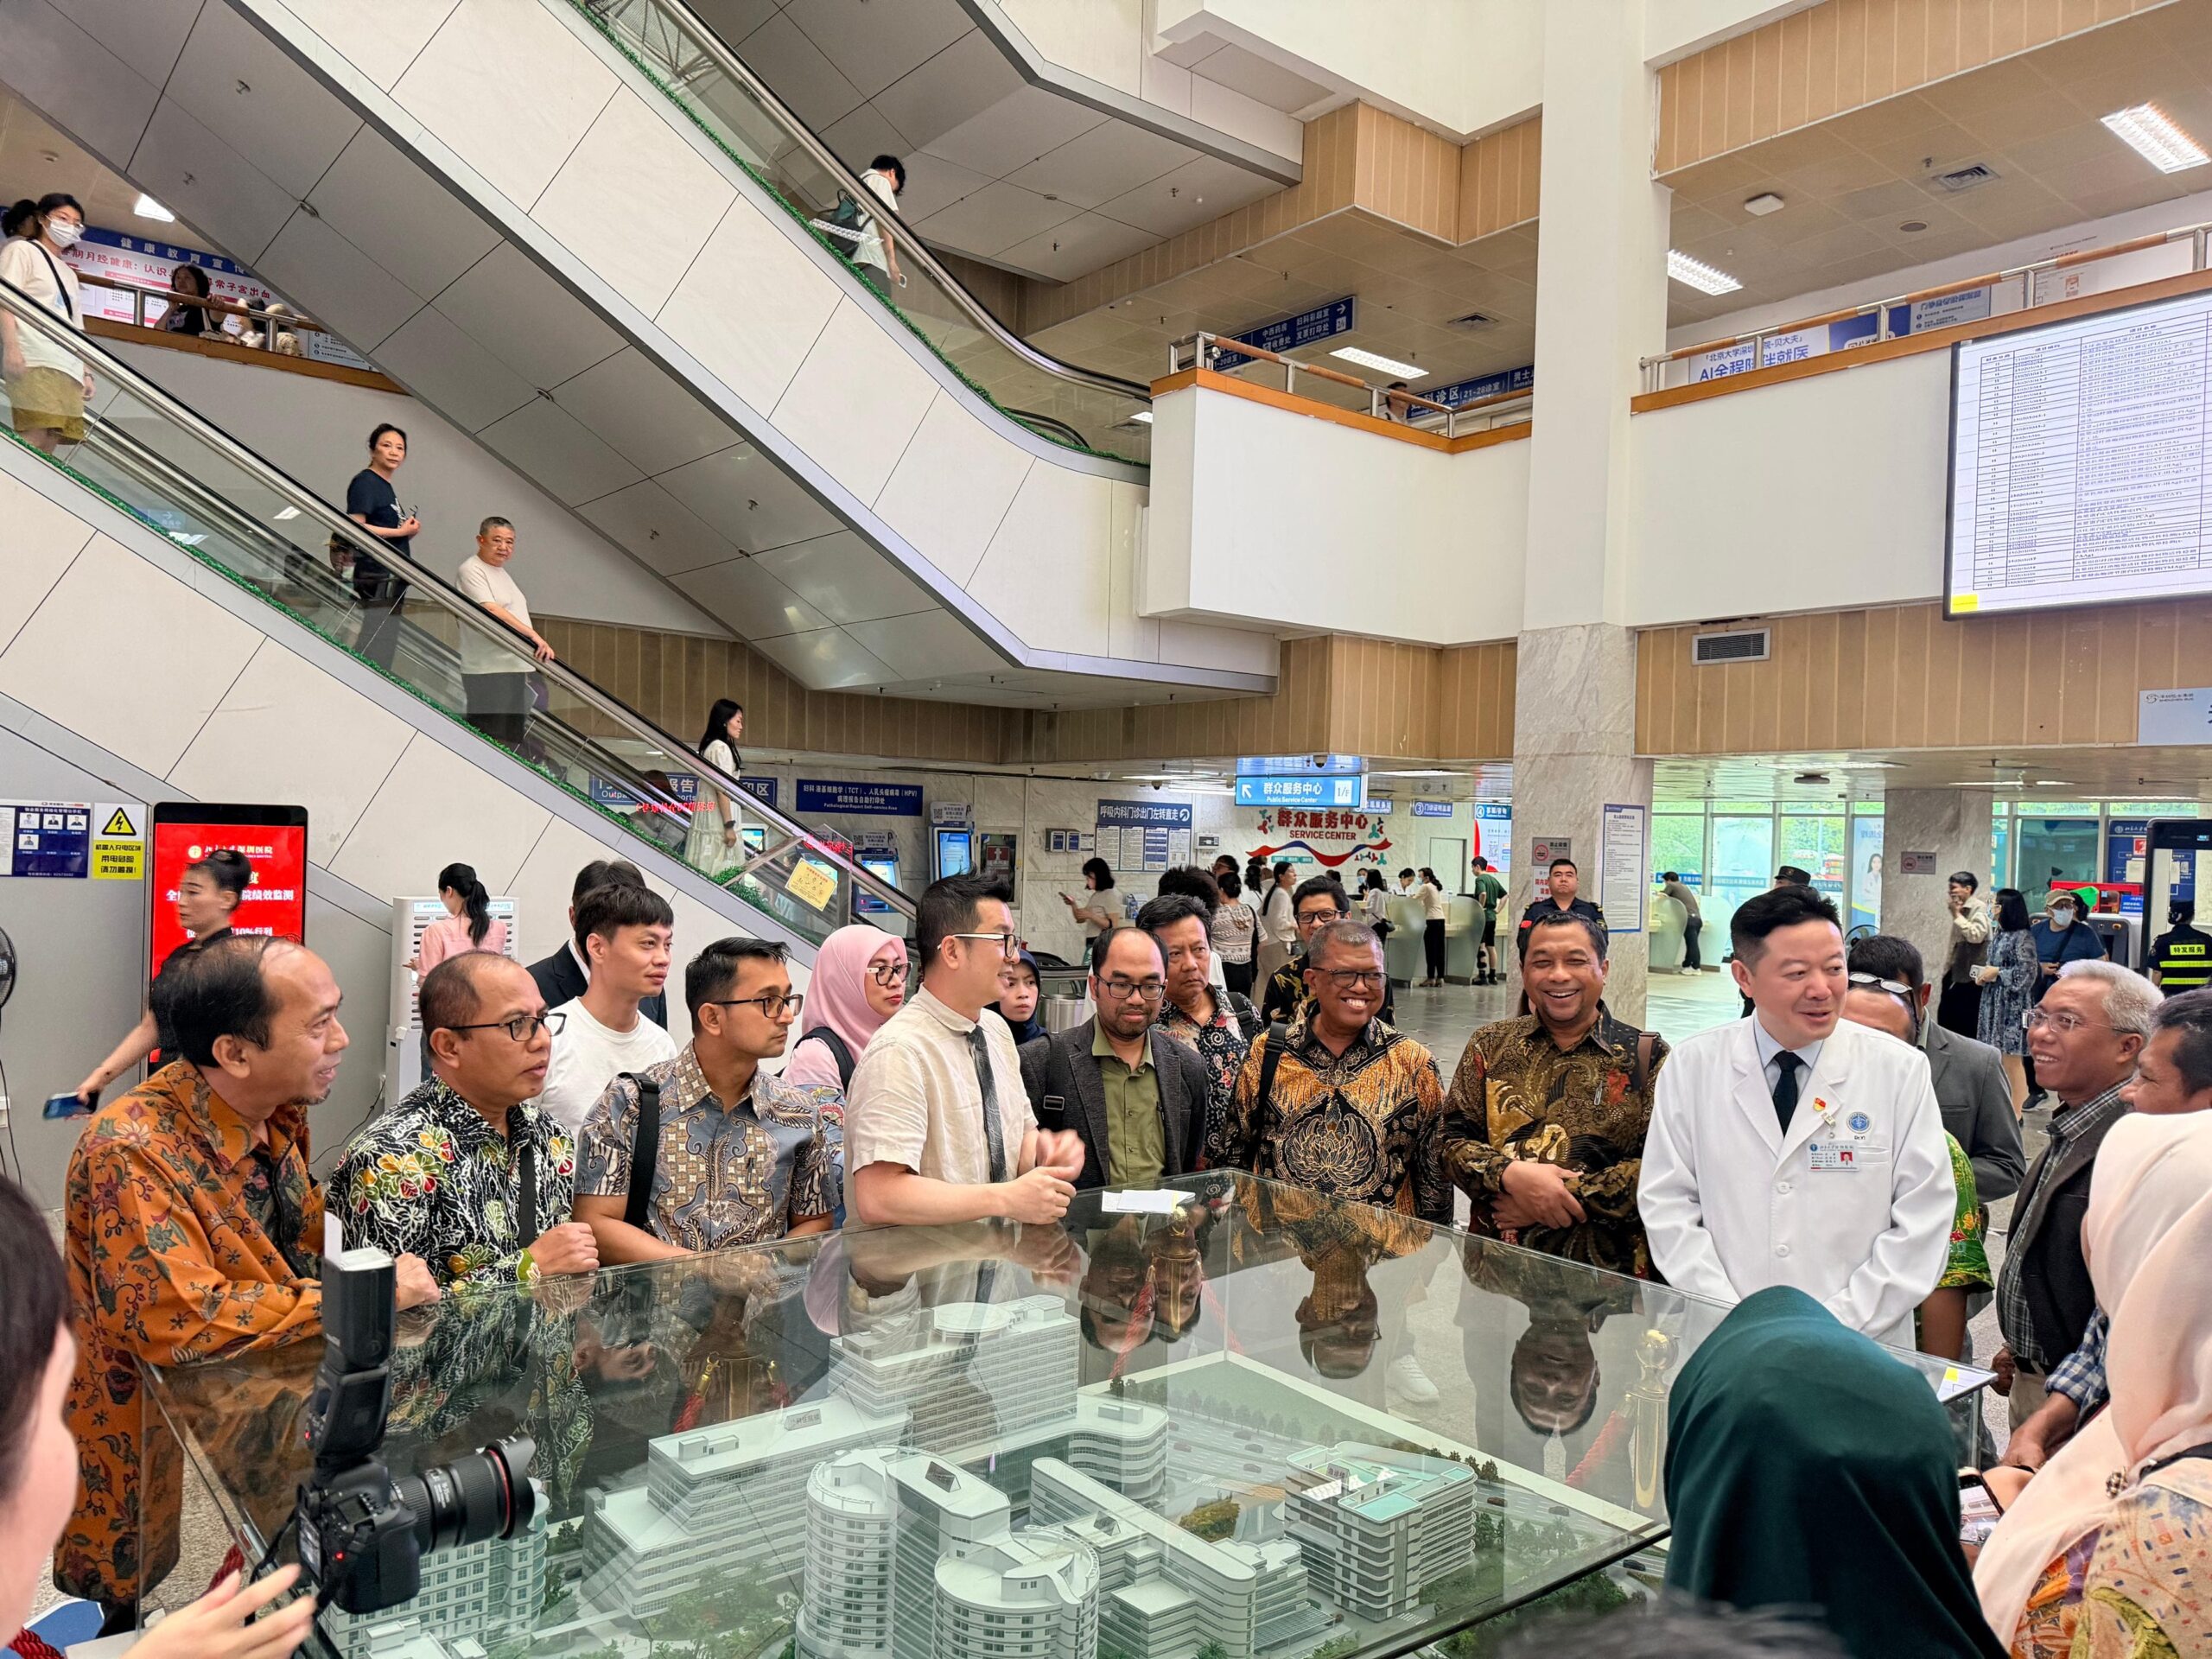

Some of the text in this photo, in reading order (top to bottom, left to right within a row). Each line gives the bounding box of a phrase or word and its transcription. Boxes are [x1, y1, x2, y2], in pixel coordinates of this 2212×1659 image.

[1263, 782, 1322, 795] 群众服务中心
[1100, 805, 1179, 821] 呼吸内科门诊出门左转直走
[1277, 809, 1368, 830] 群众服务中心
[1289, 830, 1357, 841] SERVICE CENTER
[2173, 945, 2203, 954] 特发服务
